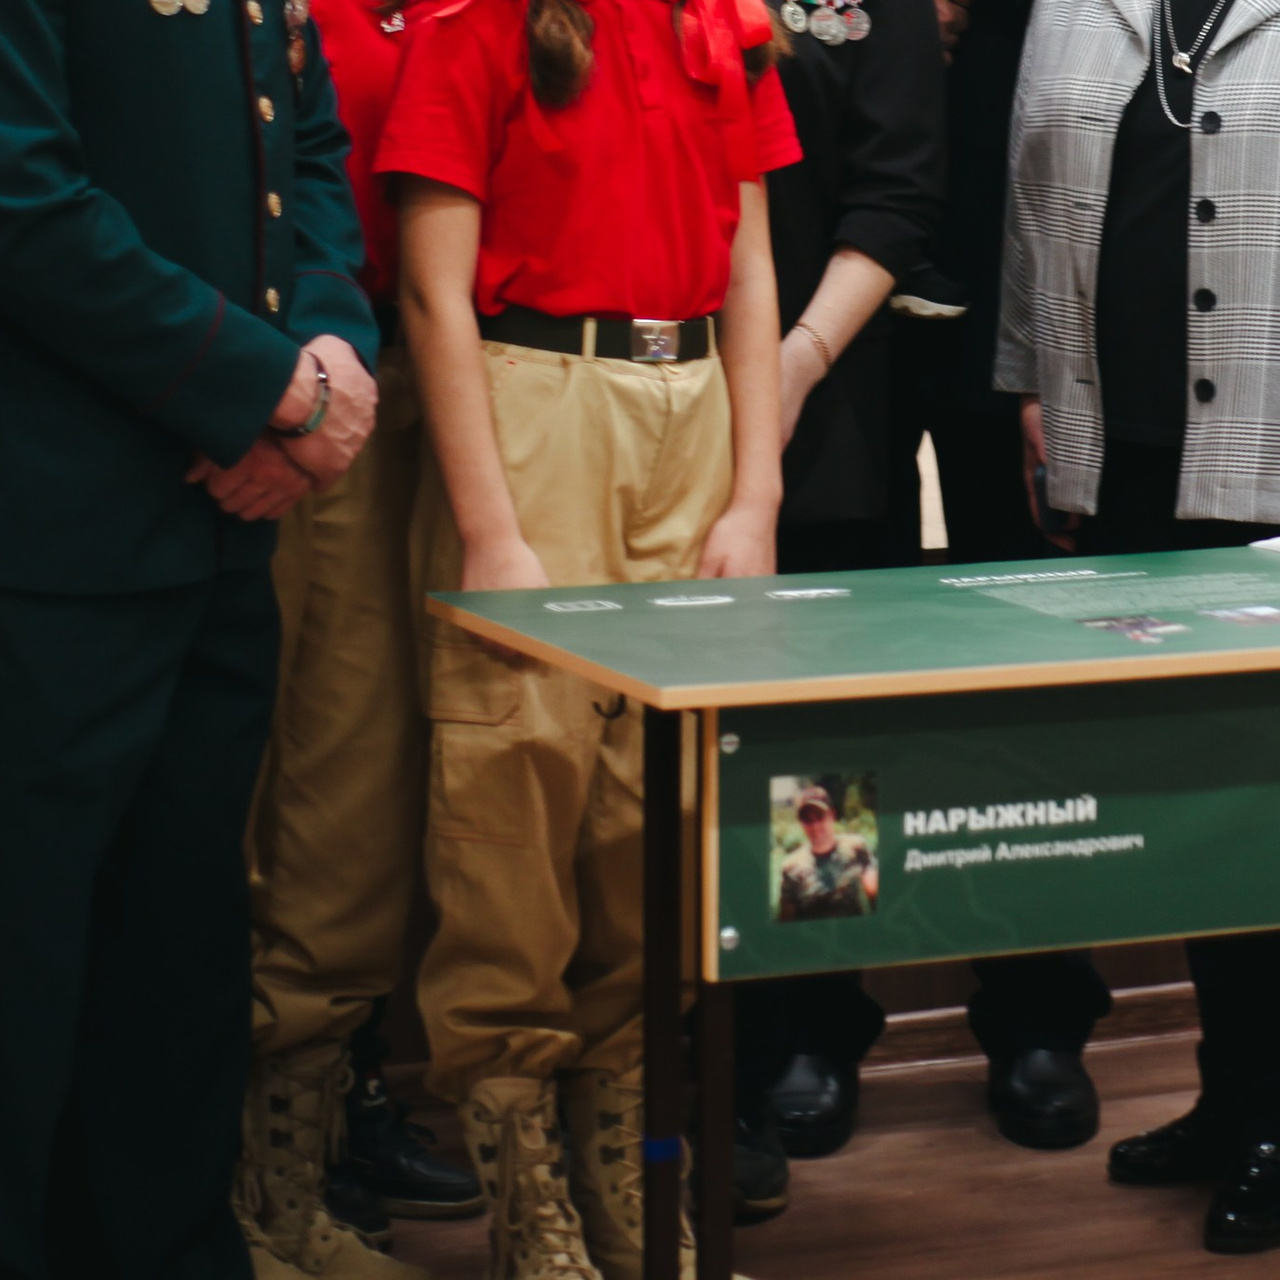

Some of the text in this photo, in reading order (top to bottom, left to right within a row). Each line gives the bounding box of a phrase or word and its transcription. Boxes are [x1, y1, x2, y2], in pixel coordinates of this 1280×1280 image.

[904, 794, 1097, 836] НАРЫЖНЫЙ
[904, 834, 1145, 870] Дмитрий Александрович
